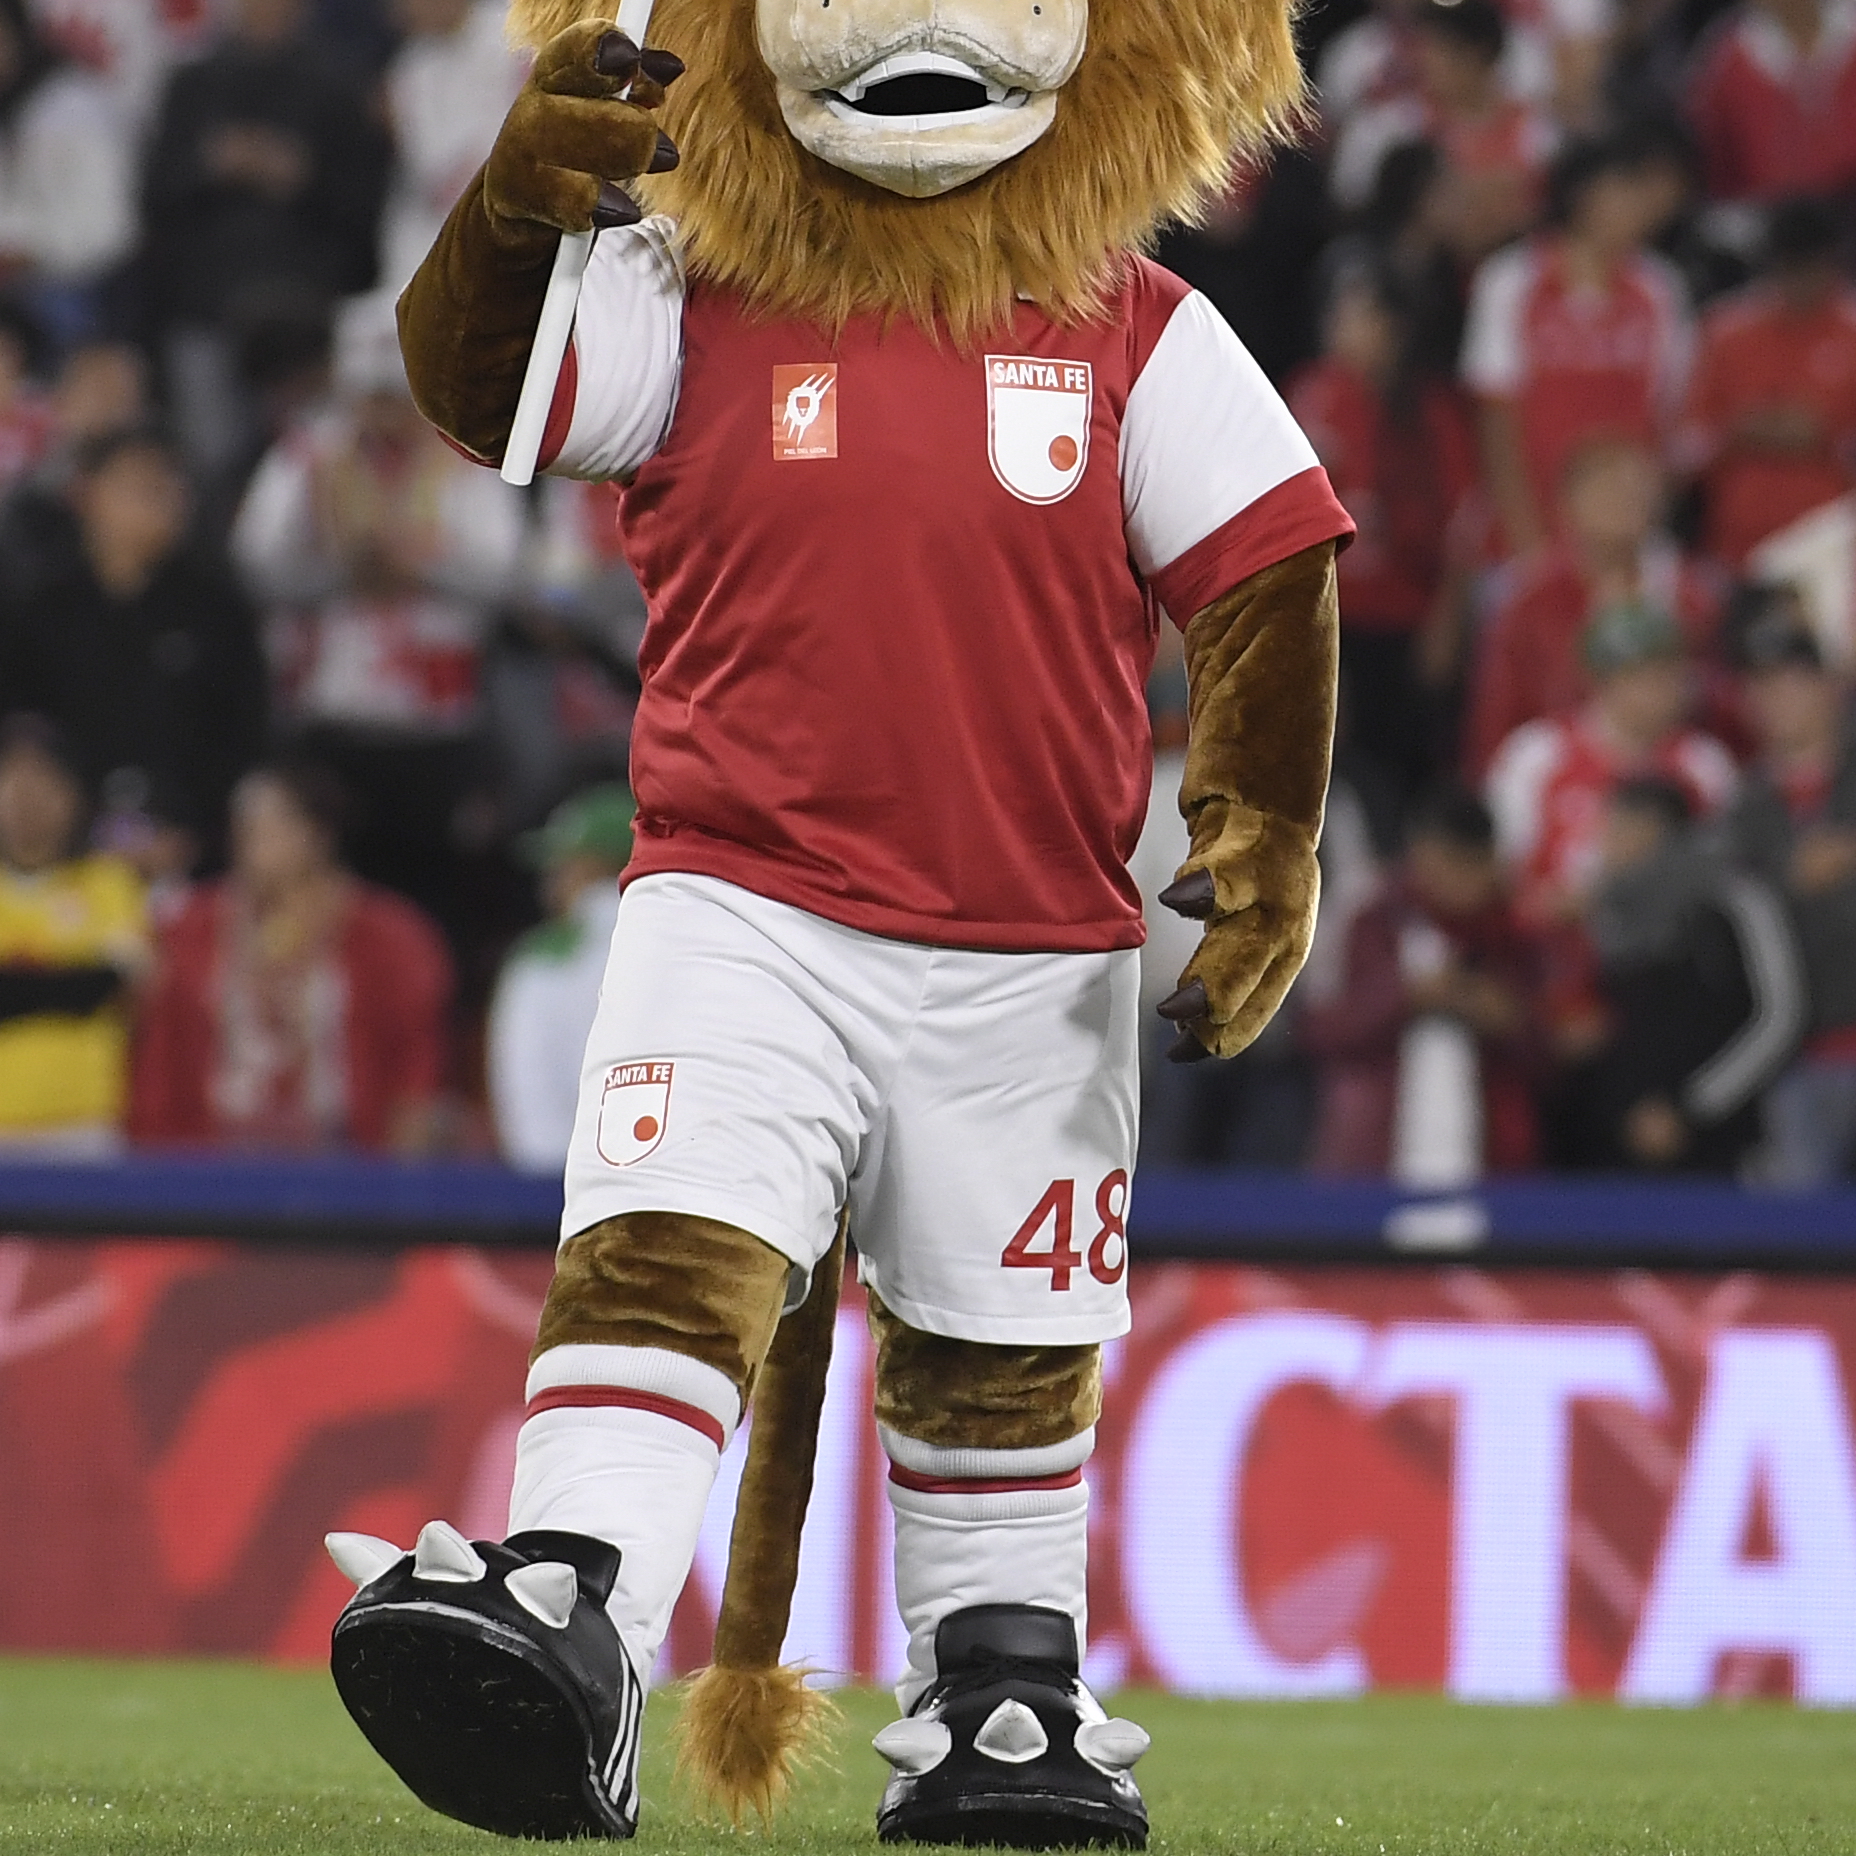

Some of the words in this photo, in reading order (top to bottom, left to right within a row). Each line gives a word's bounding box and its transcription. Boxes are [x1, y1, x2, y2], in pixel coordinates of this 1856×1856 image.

[993, 362, 1059, 388] SANTA
[1064, 367, 1086, 391] FE
[606, 1065, 648, 1088] SANTA
[651, 1064, 671, 1082] FE
[1001, 1168, 1128, 1291] 48
